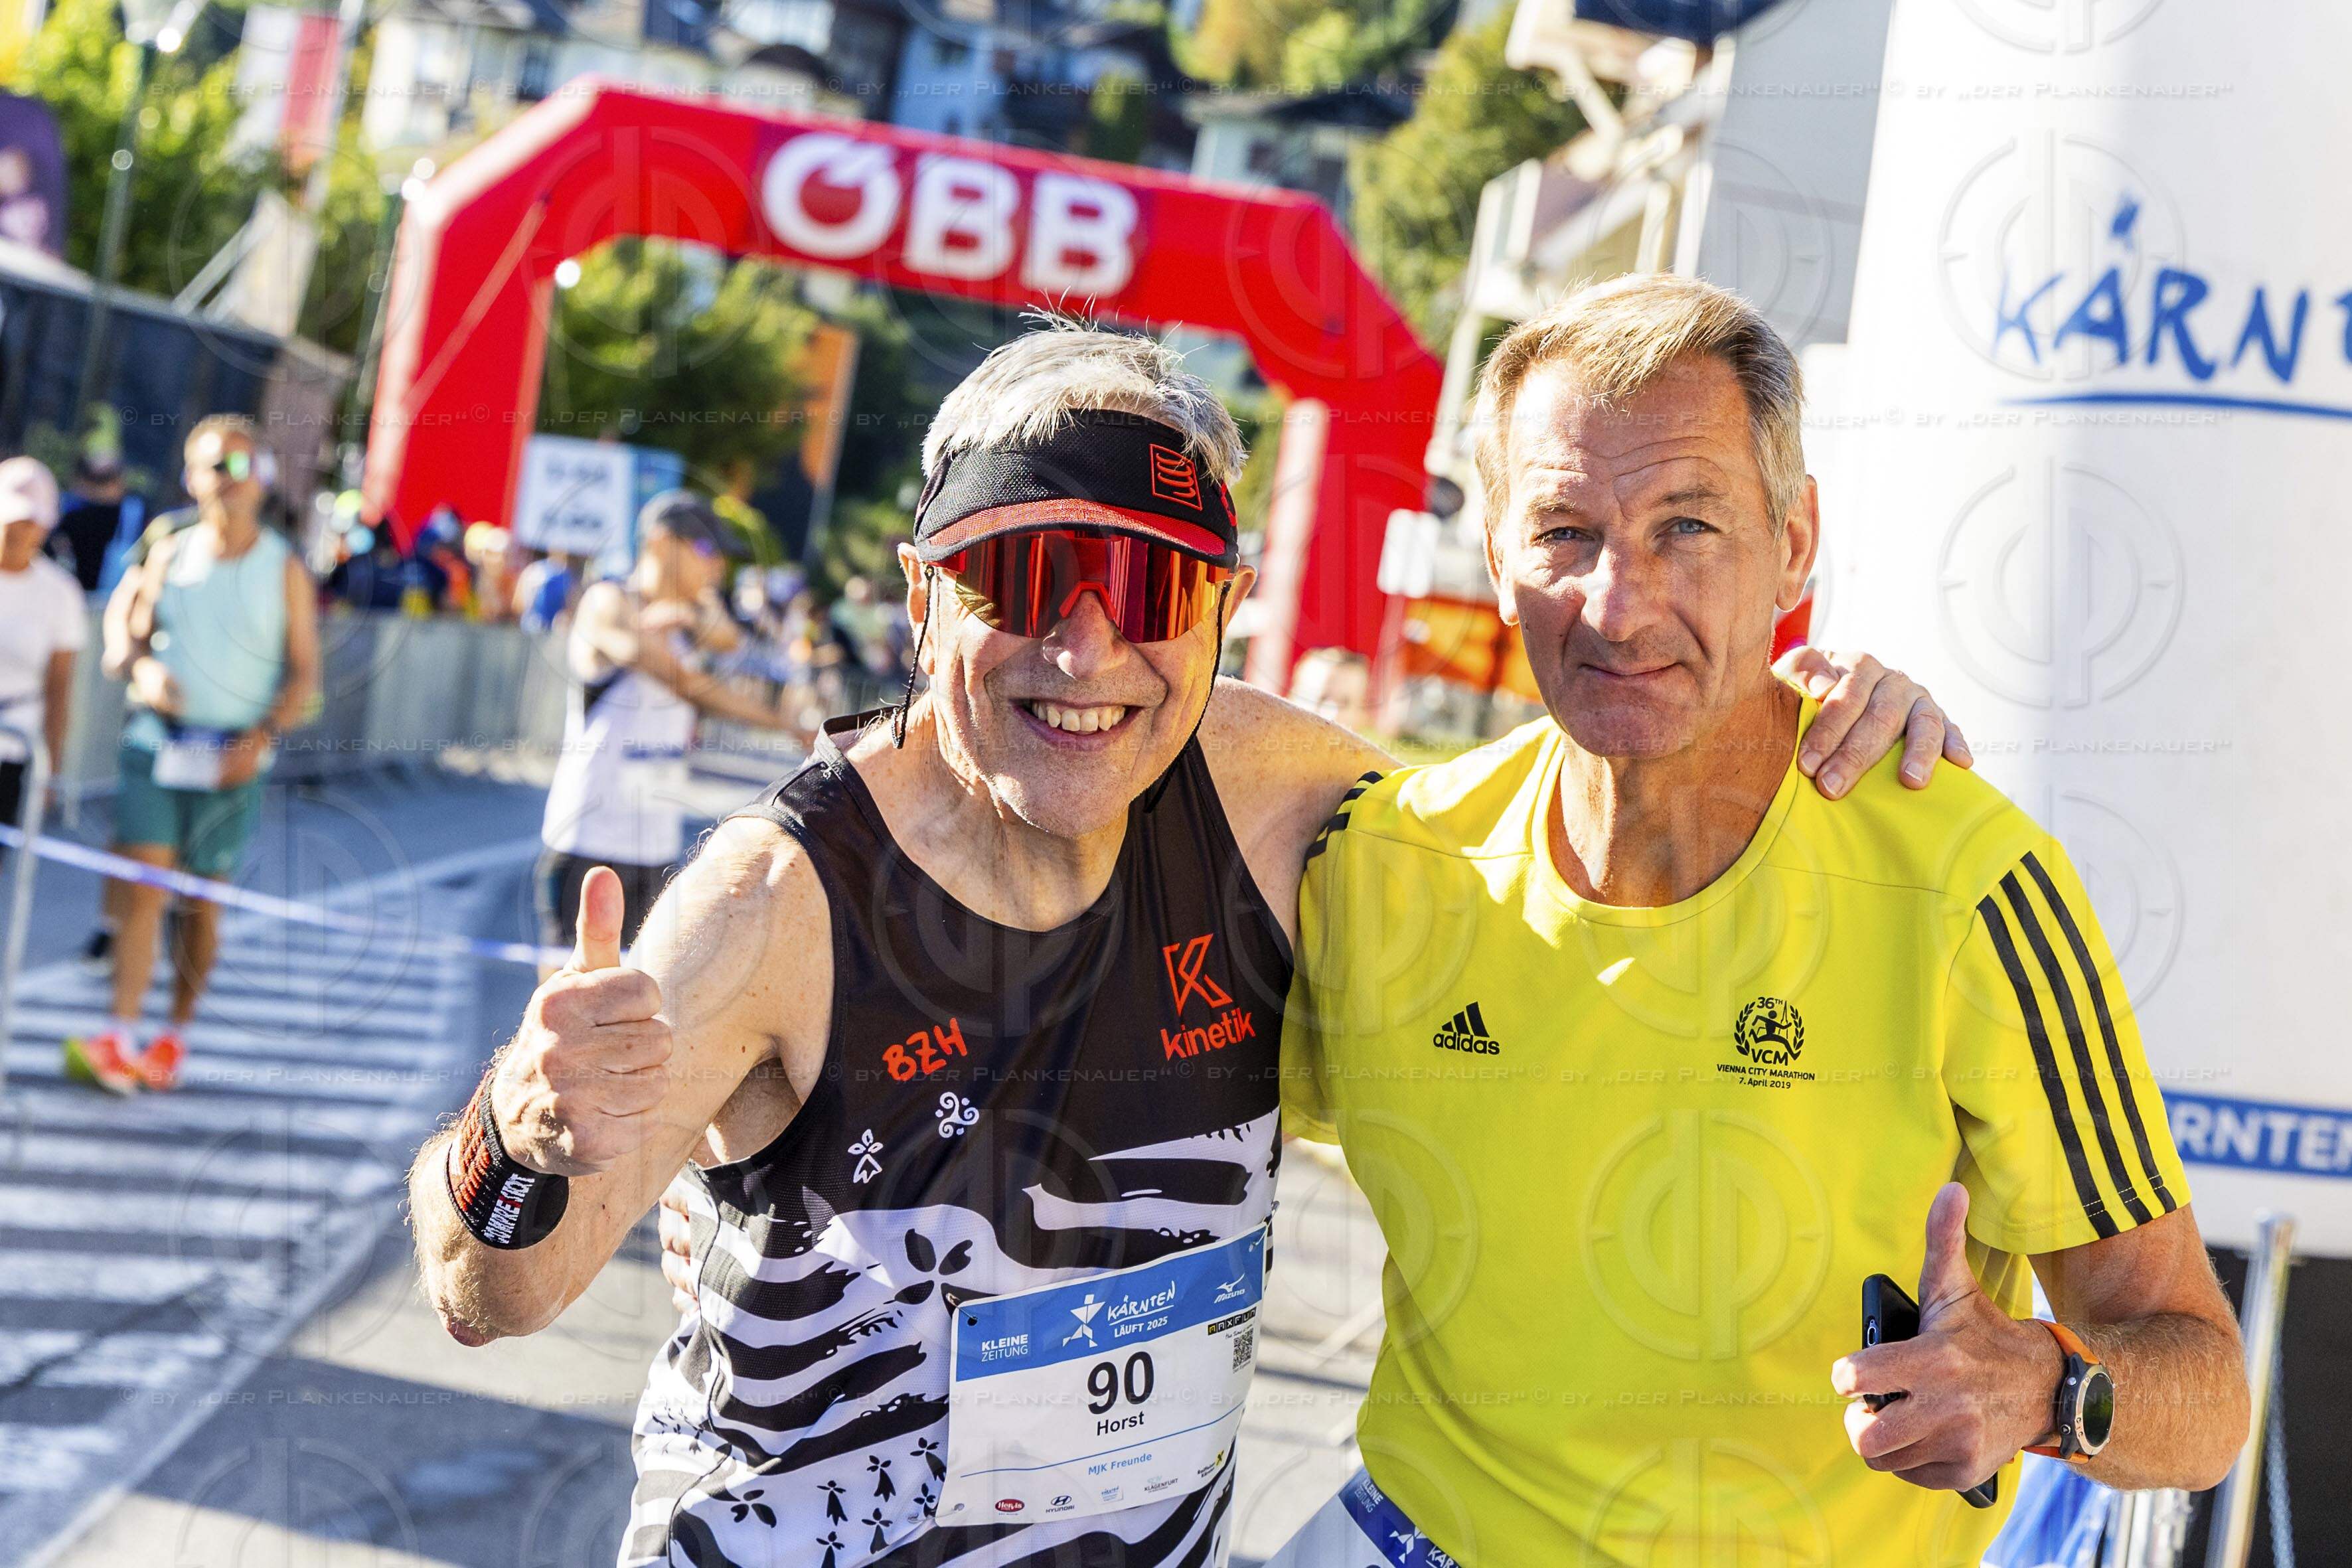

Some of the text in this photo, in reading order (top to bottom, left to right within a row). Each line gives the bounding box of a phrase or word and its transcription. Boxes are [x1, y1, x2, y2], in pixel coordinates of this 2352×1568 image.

[1160, 1007, 1256, 1061] kinetik
[1433, 1032, 1500, 1056] adidas
[882, 1017, 968, 1081] BZH
[1751, 1049, 1788, 1066] VCM
[1717, 1063, 1816, 1081] VIENNA CITY MARATHON
[1747, 1078, 1767, 1087] April
[1770, 1080, 1791, 1089] 2019
[1114, 1316, 1168, 1338] LÄUFT 2025
[981, 1334, 1028, 1352] KLEINE
[981, 1345, 1028, 1362] ZEITUNG
[1086, 1352, 1154, 1415] 90
[1096, 1411, 1145, 1437] Horst
[1088, 1453, 1152, 1476] MJK Freunde
[1144, 1478, 1178, 1491] KLAGENFURT
[1362, 1476, 1383, 1505] KLEINE
[998, 1502, 1022, 1510] Hervis
